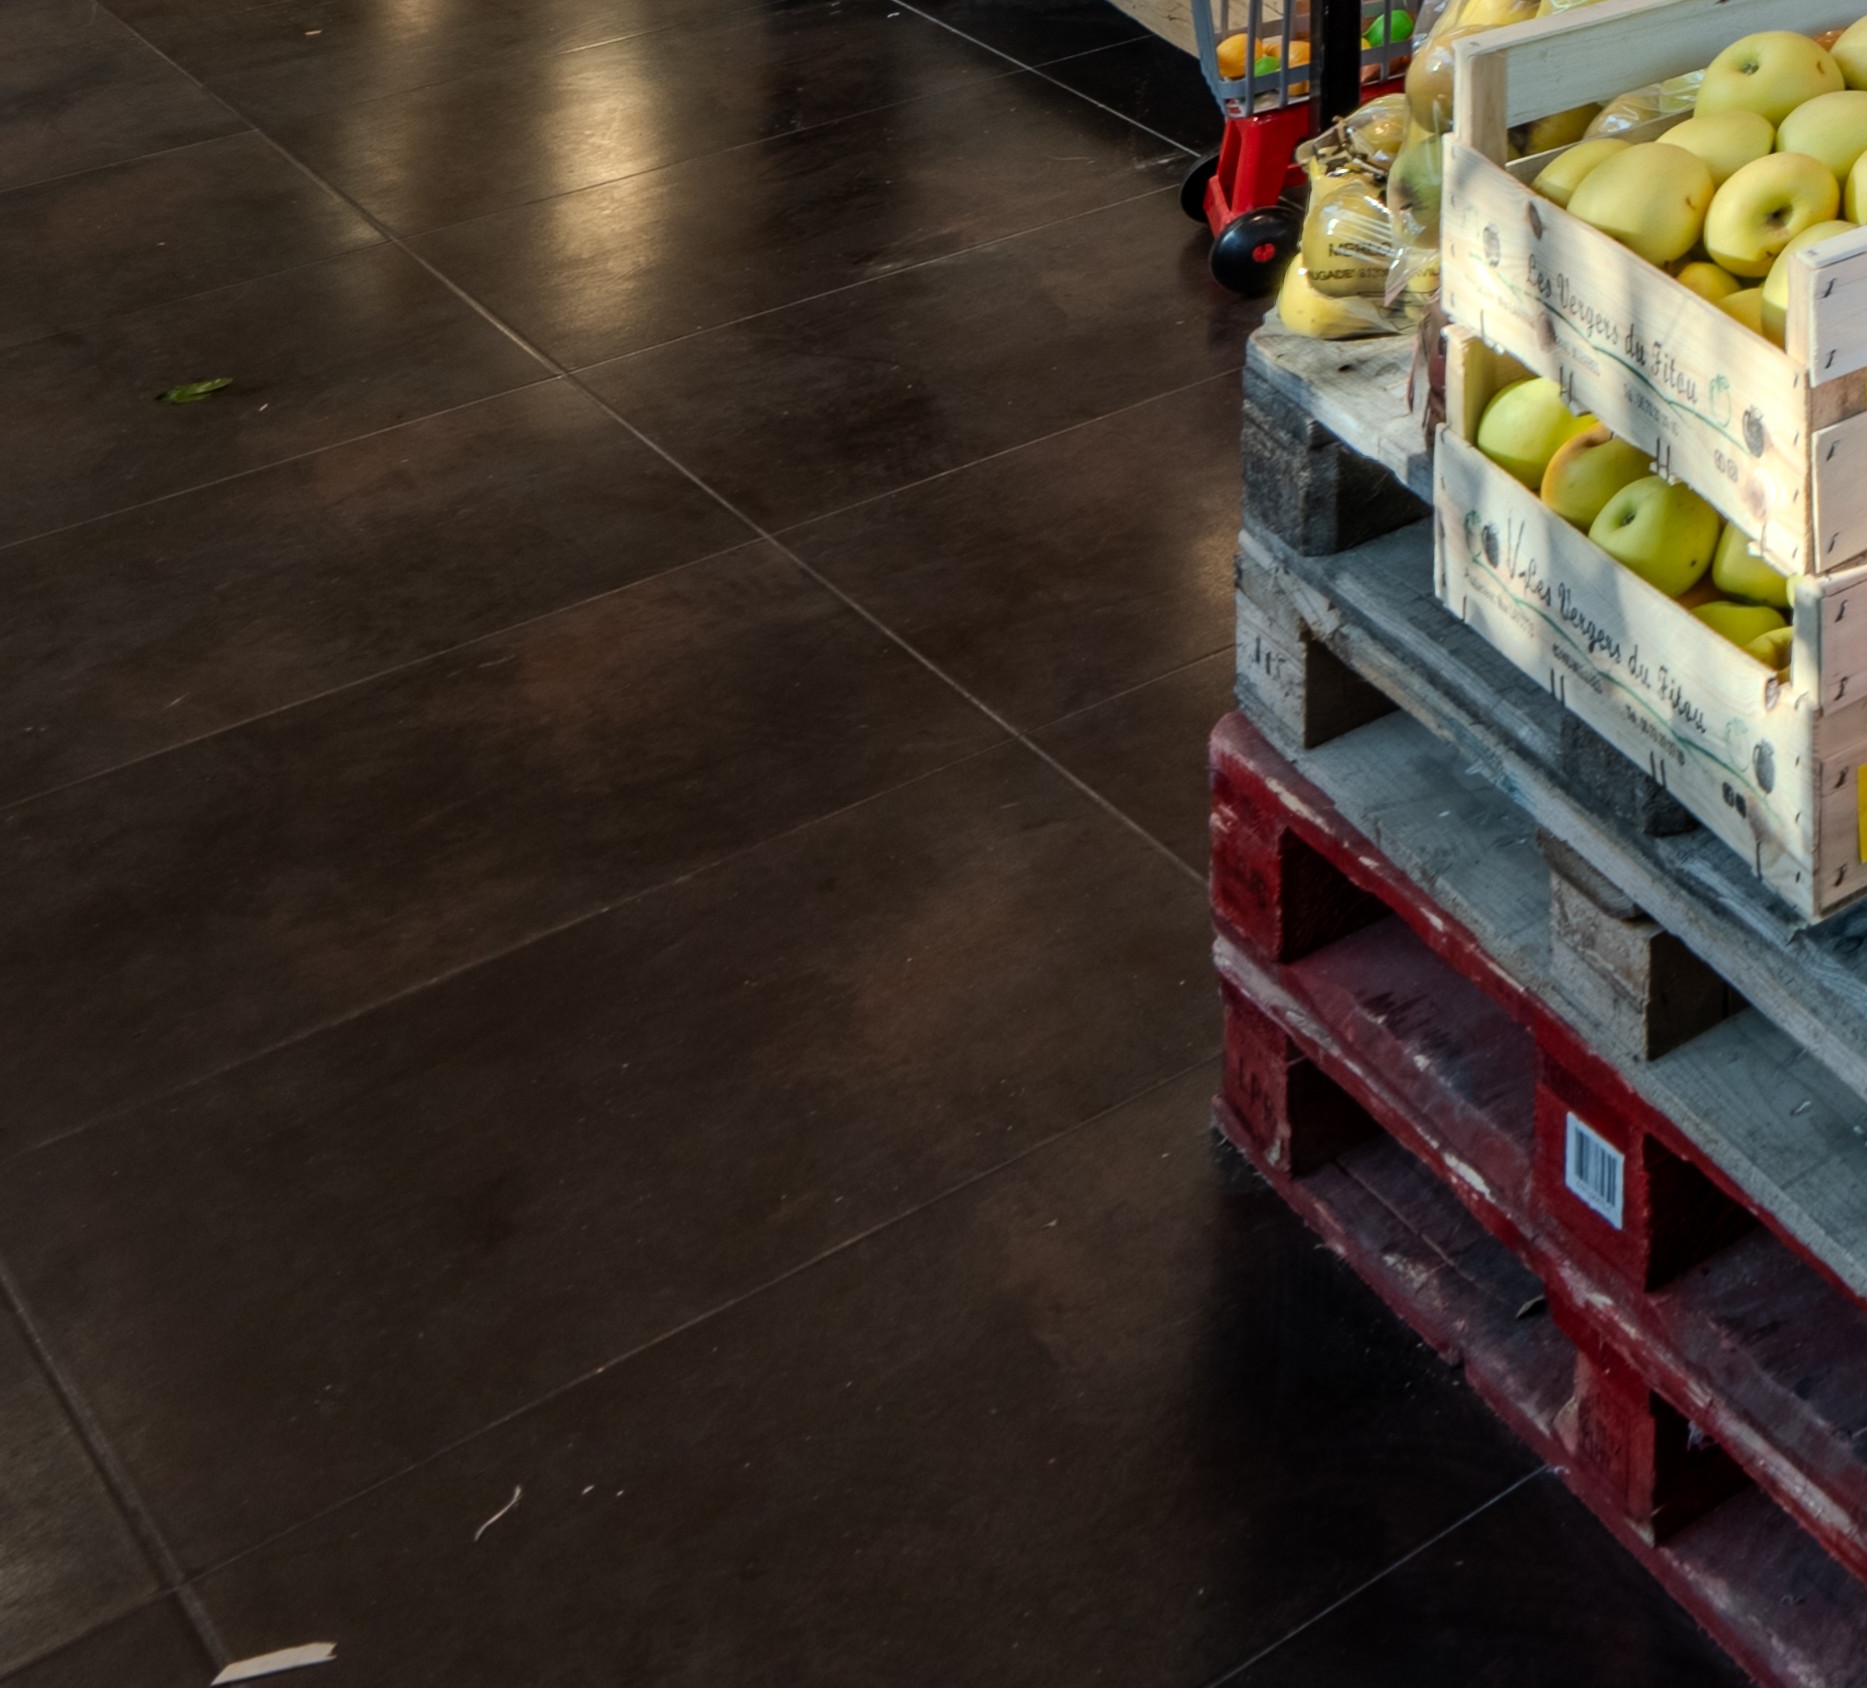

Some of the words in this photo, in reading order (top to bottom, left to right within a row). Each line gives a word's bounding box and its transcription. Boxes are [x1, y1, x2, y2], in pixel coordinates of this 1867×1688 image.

[1527, 253, 1551, 299] Les
[1557, 273, 1619, 345] Vergers
[1625, 323, 1645, 366] du
[1651, 341, 1698, 404] Fitou
[1558, 582, 1621, 664] Vergers
[1628, 644, 1651, 689] du
[1659, 664, 1706, 735] Fitou
